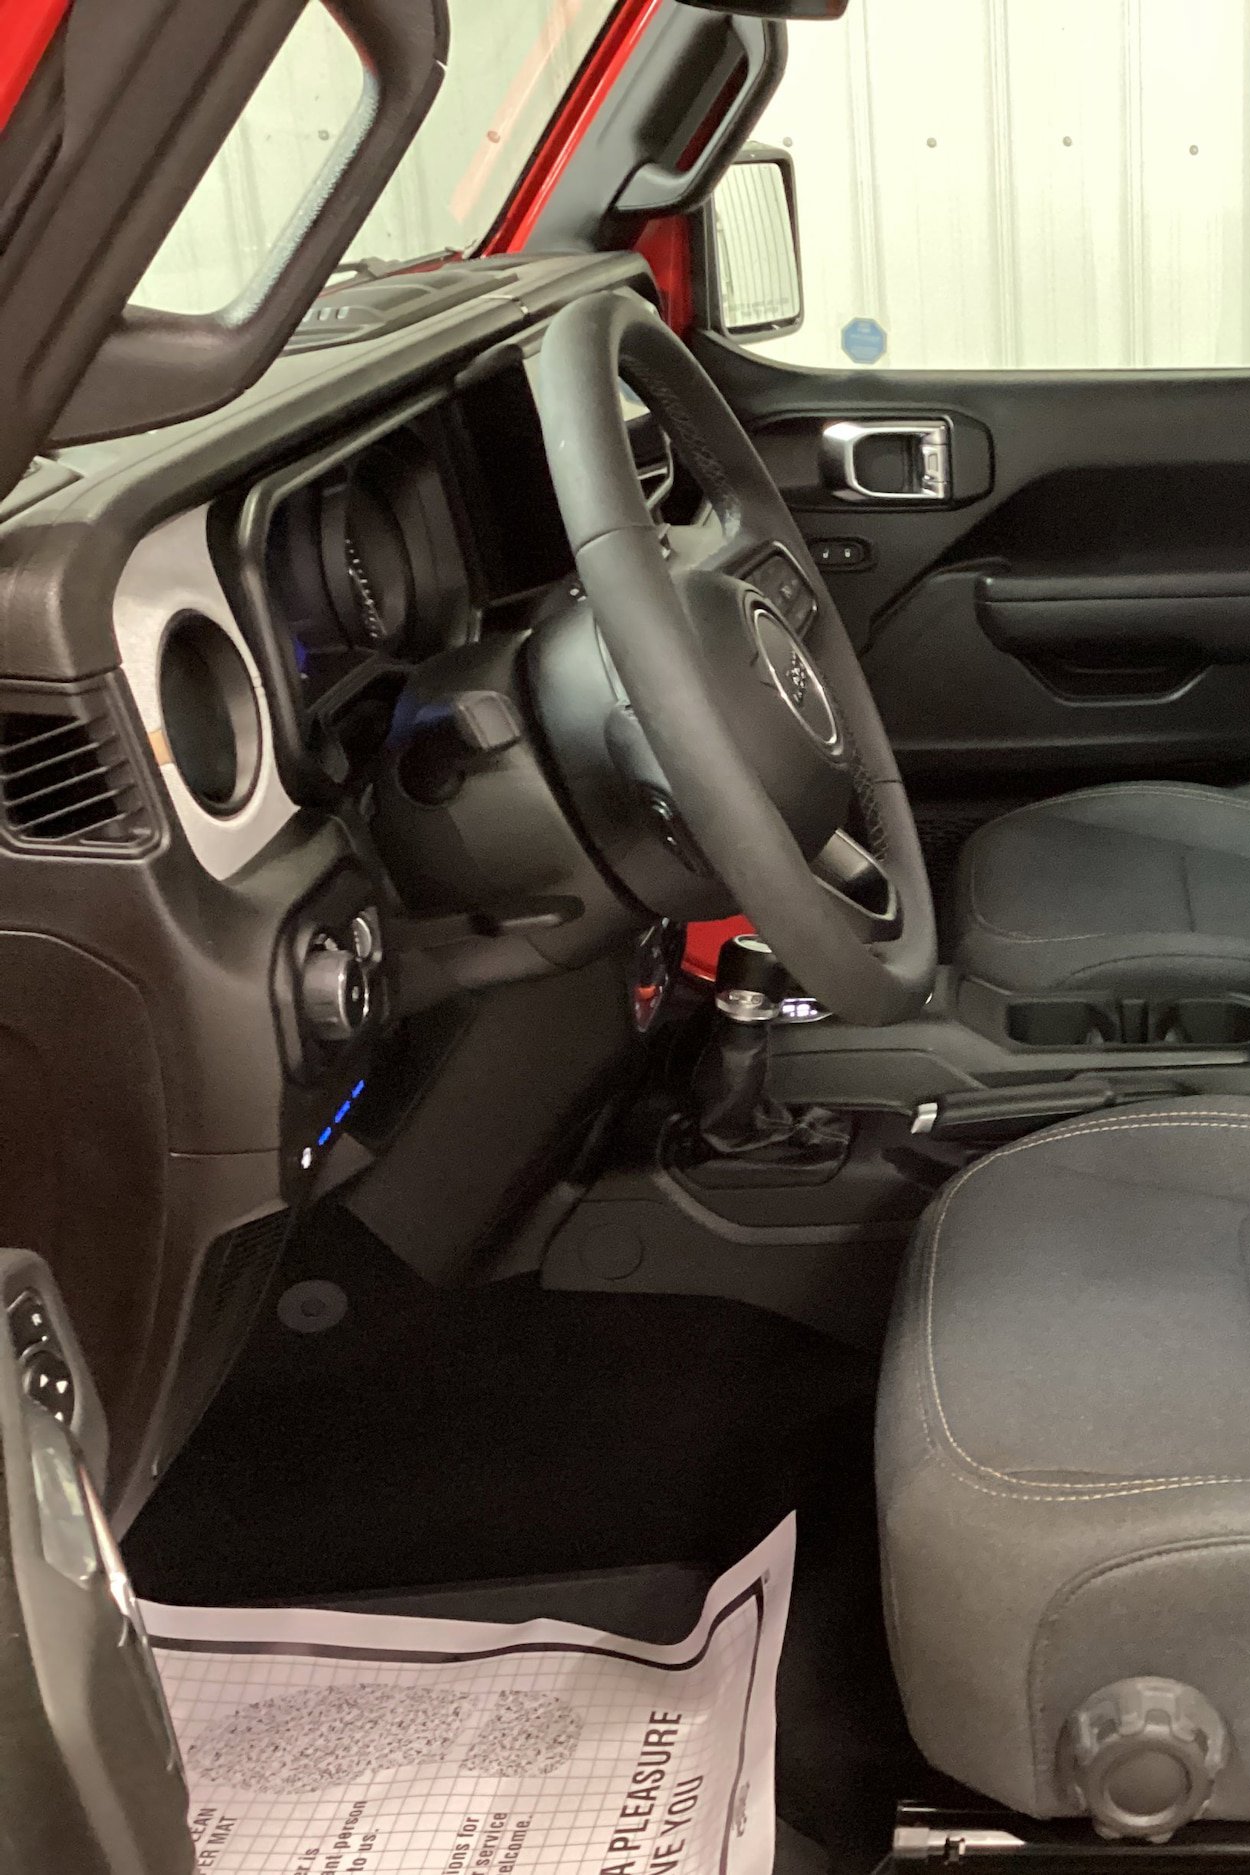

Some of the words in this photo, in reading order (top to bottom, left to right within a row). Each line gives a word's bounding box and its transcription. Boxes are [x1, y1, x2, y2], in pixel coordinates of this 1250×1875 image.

[608, 1711, 682, 1852] PLEASURE
[660, 1775, 704, 1836] YOU
[207, 1815, 238, 1844] MAT
[333, 1801, 368, 1849] person
[457, 1817, 480, 1837] for
[476, 1812, 508, 1866] service
[497, 1815, 535, 1875] elcome.
[298, 1848, 320, 1861] is
[346, 1857, 367, 1872] to
[358, 1829, 380, 1851] us.
